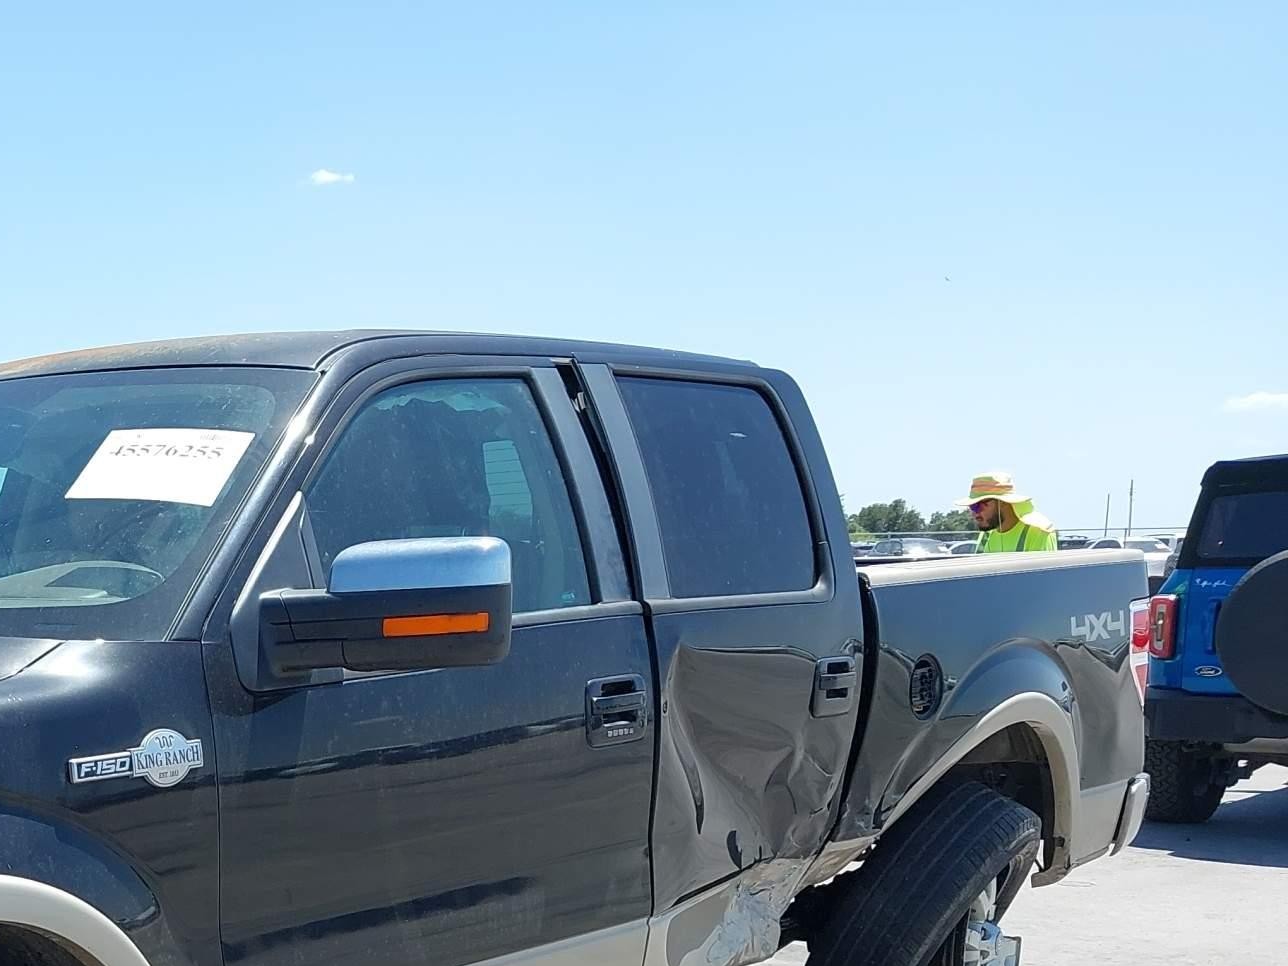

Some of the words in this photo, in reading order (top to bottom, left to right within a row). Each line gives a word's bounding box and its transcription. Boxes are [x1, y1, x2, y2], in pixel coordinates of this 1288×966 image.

[1070, 609, 1125, 642] 4X4
[134, 752, 163, 770] KING
[164, 745, 201, 767] RANCH
